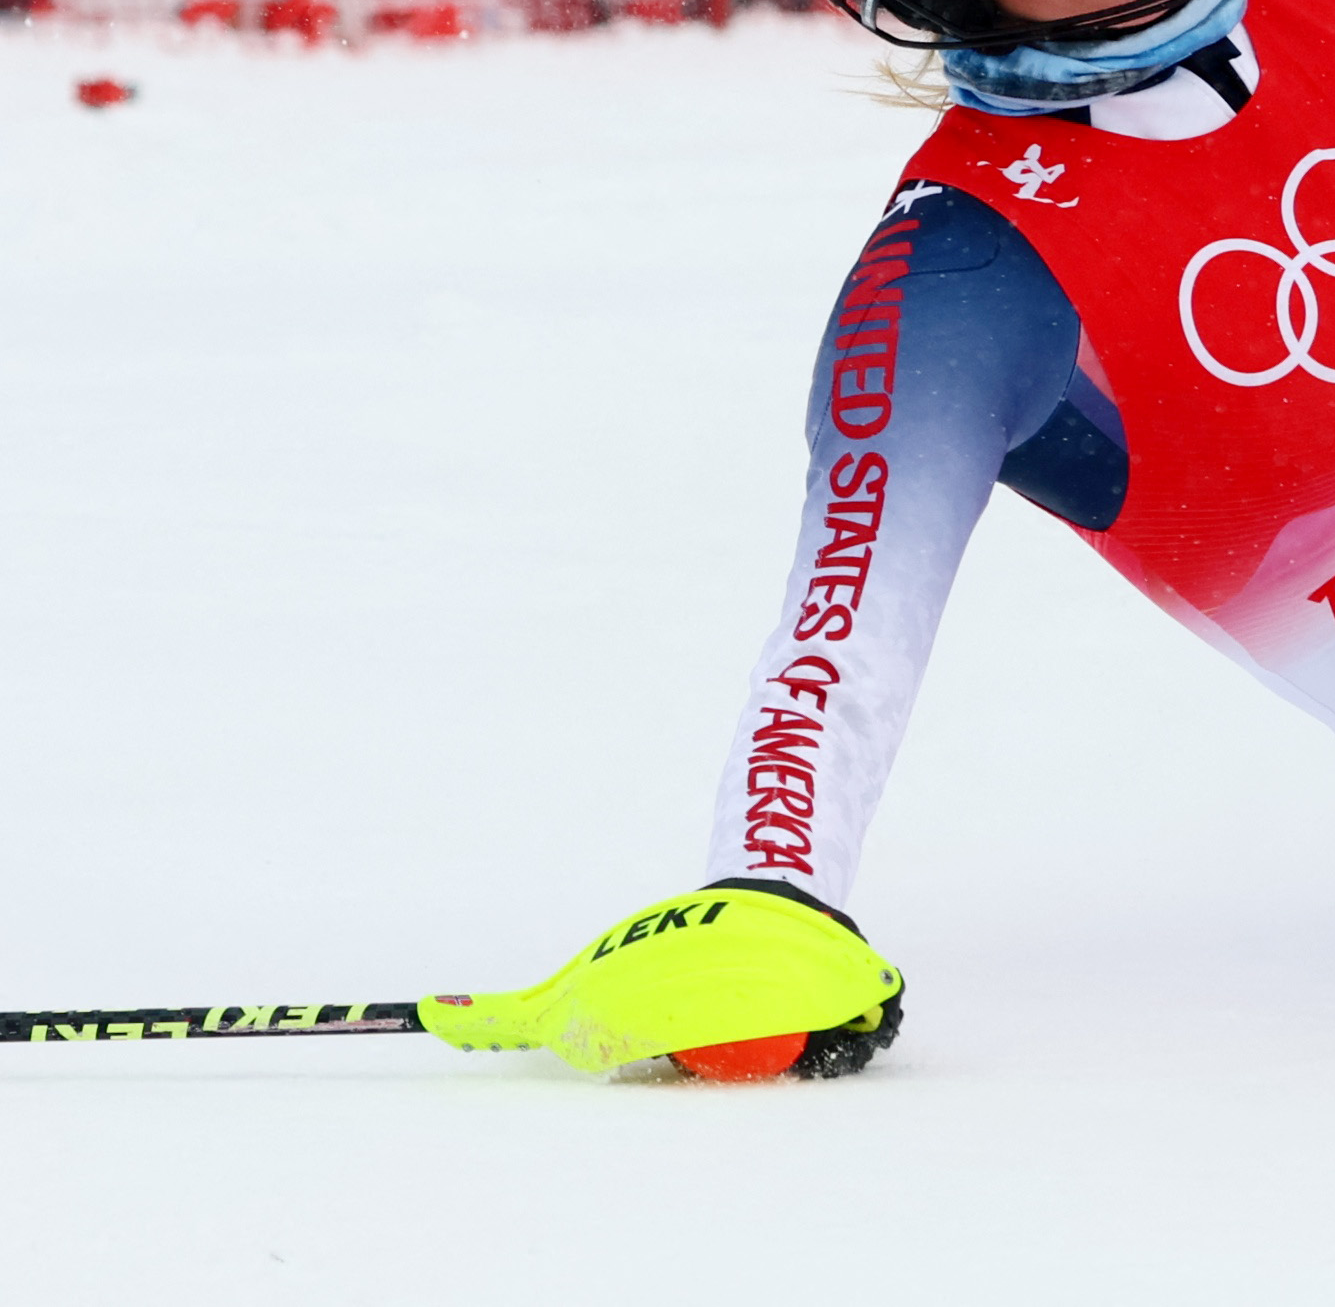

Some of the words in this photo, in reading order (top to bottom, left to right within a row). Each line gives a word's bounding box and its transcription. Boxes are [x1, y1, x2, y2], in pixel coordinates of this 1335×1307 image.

[831, 218, 920, 440] UNITED
[793, 451, 889, 642] STATES
[766, 654, 841, 714] OF
[744, 706, 825, 876] AMERICA
[589, 901, 730, 964] LEKI
